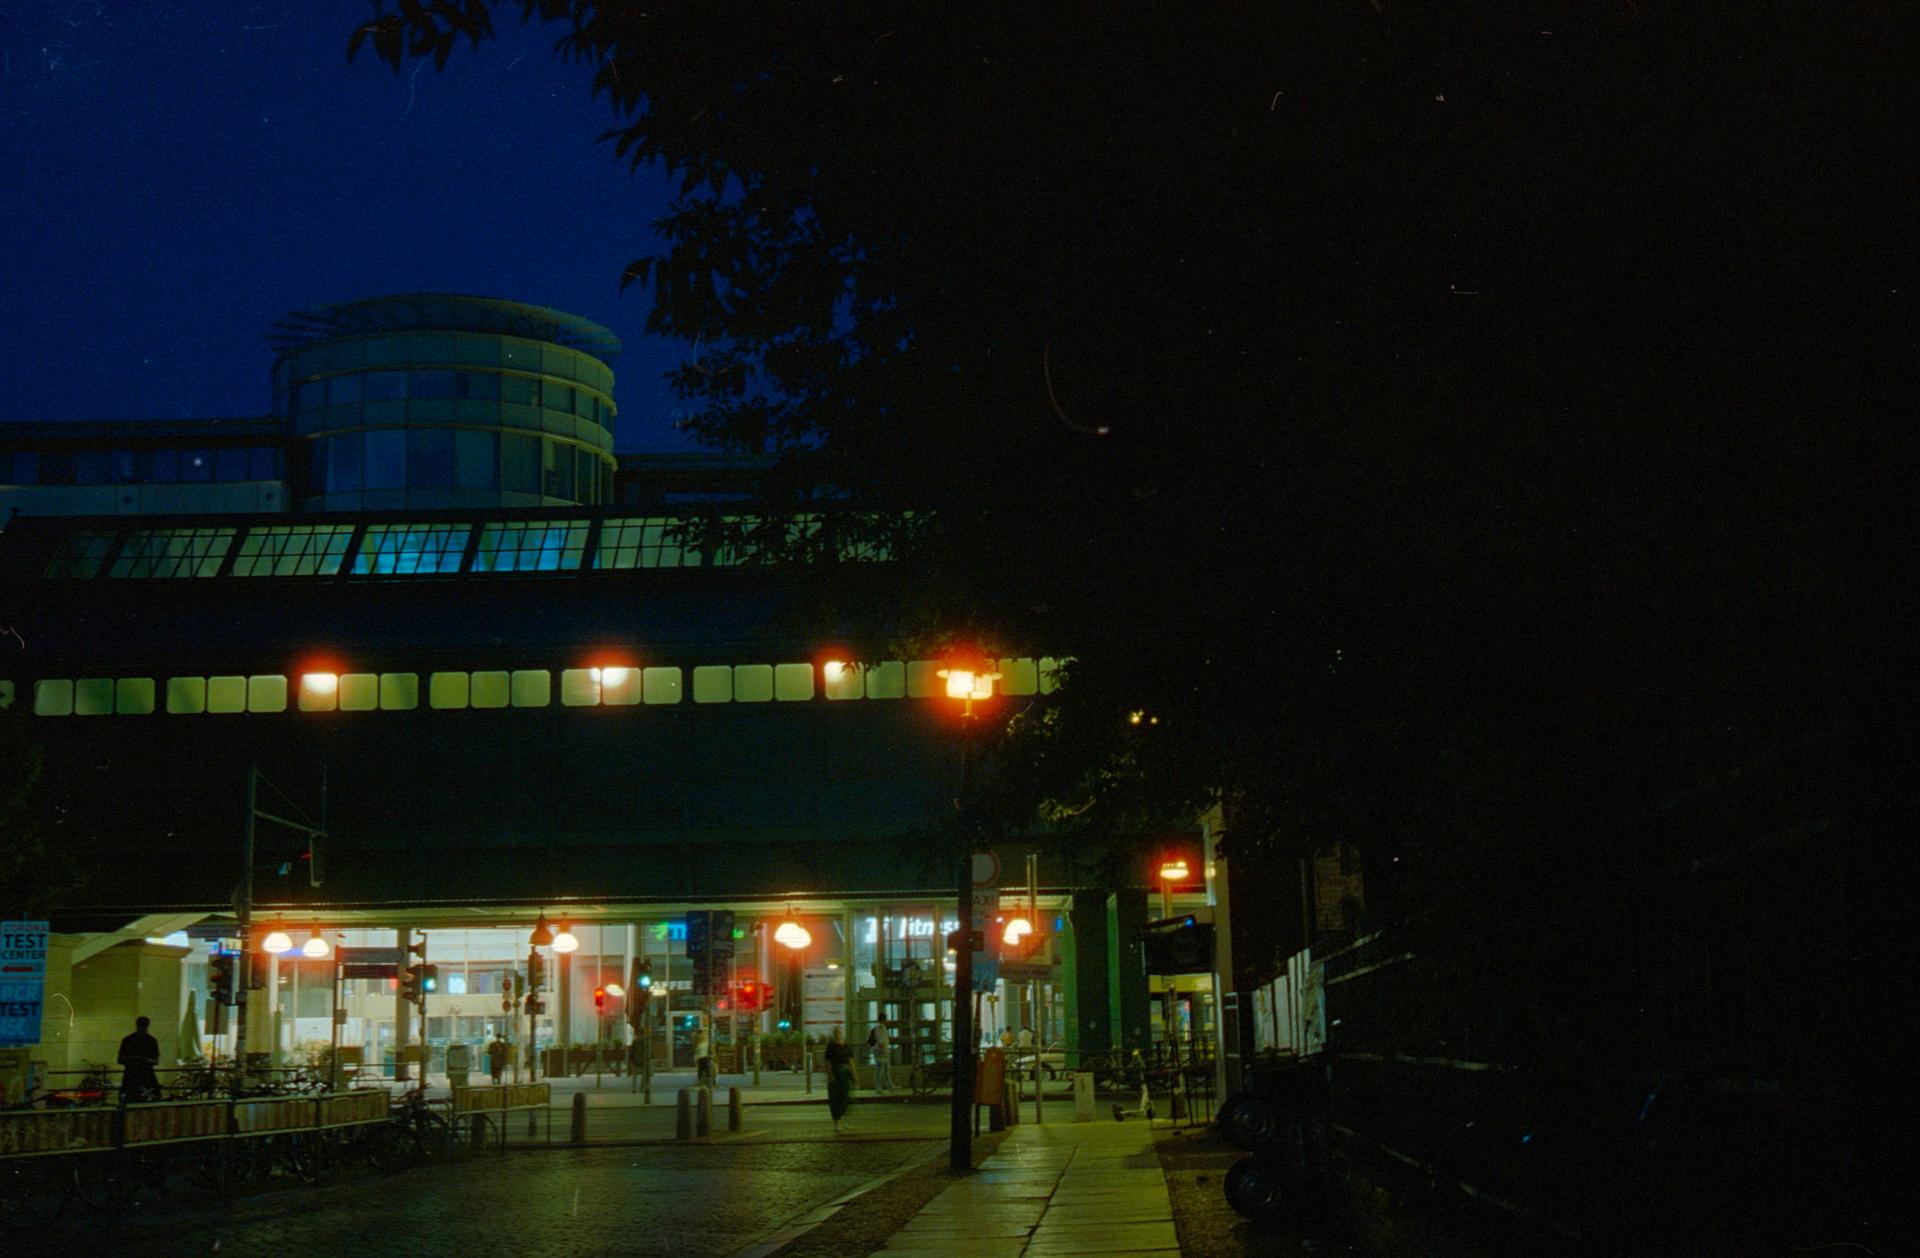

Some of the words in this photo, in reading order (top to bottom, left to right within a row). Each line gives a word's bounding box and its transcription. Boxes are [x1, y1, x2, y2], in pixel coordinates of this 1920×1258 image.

[4, 933, 46, 948] TEST
[3, 950, 46, 960] CENTER
[2, 985, 38, 1002] PCR
[0, 1001, 40, 1017] TEST
